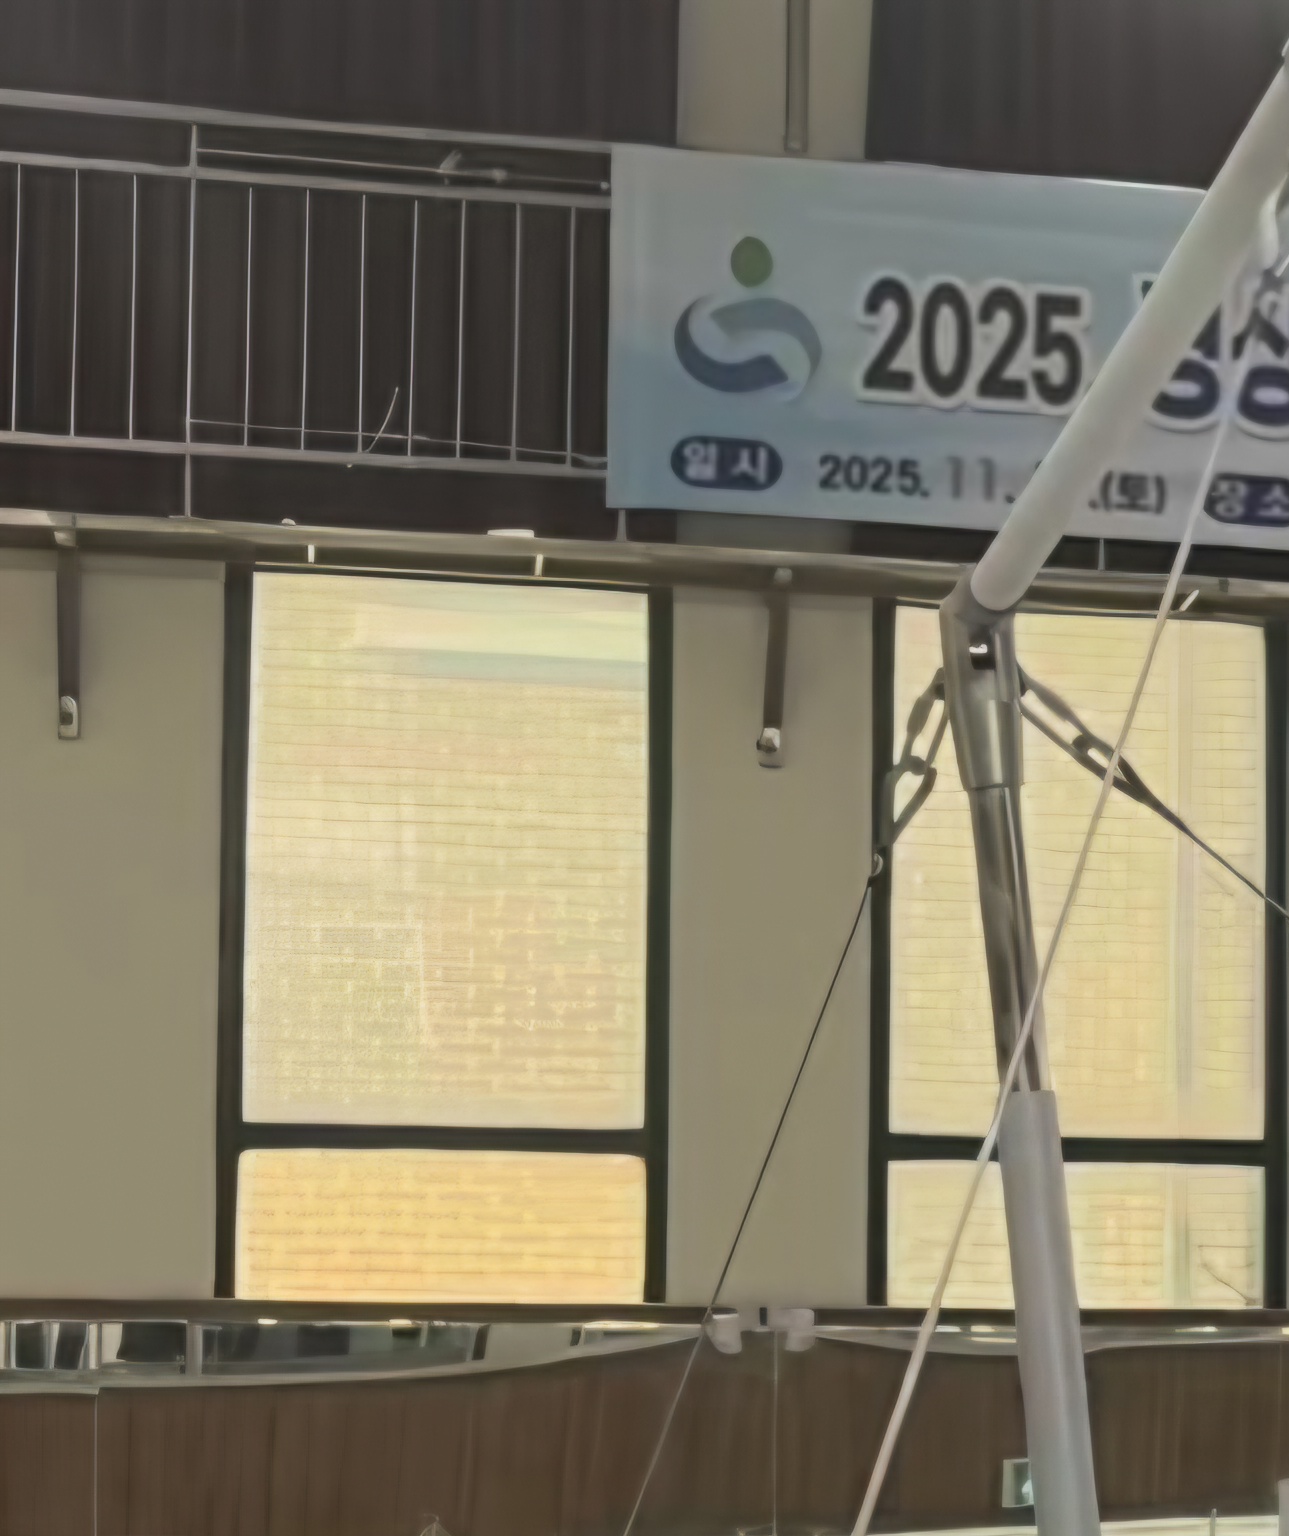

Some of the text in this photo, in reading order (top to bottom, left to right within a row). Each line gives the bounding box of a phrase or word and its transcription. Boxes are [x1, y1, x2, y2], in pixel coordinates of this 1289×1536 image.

[861, 276, 1084, 406] 2025
[682, 444, 768, 480] 일시
[818, 454, 930, 499] 2025.
